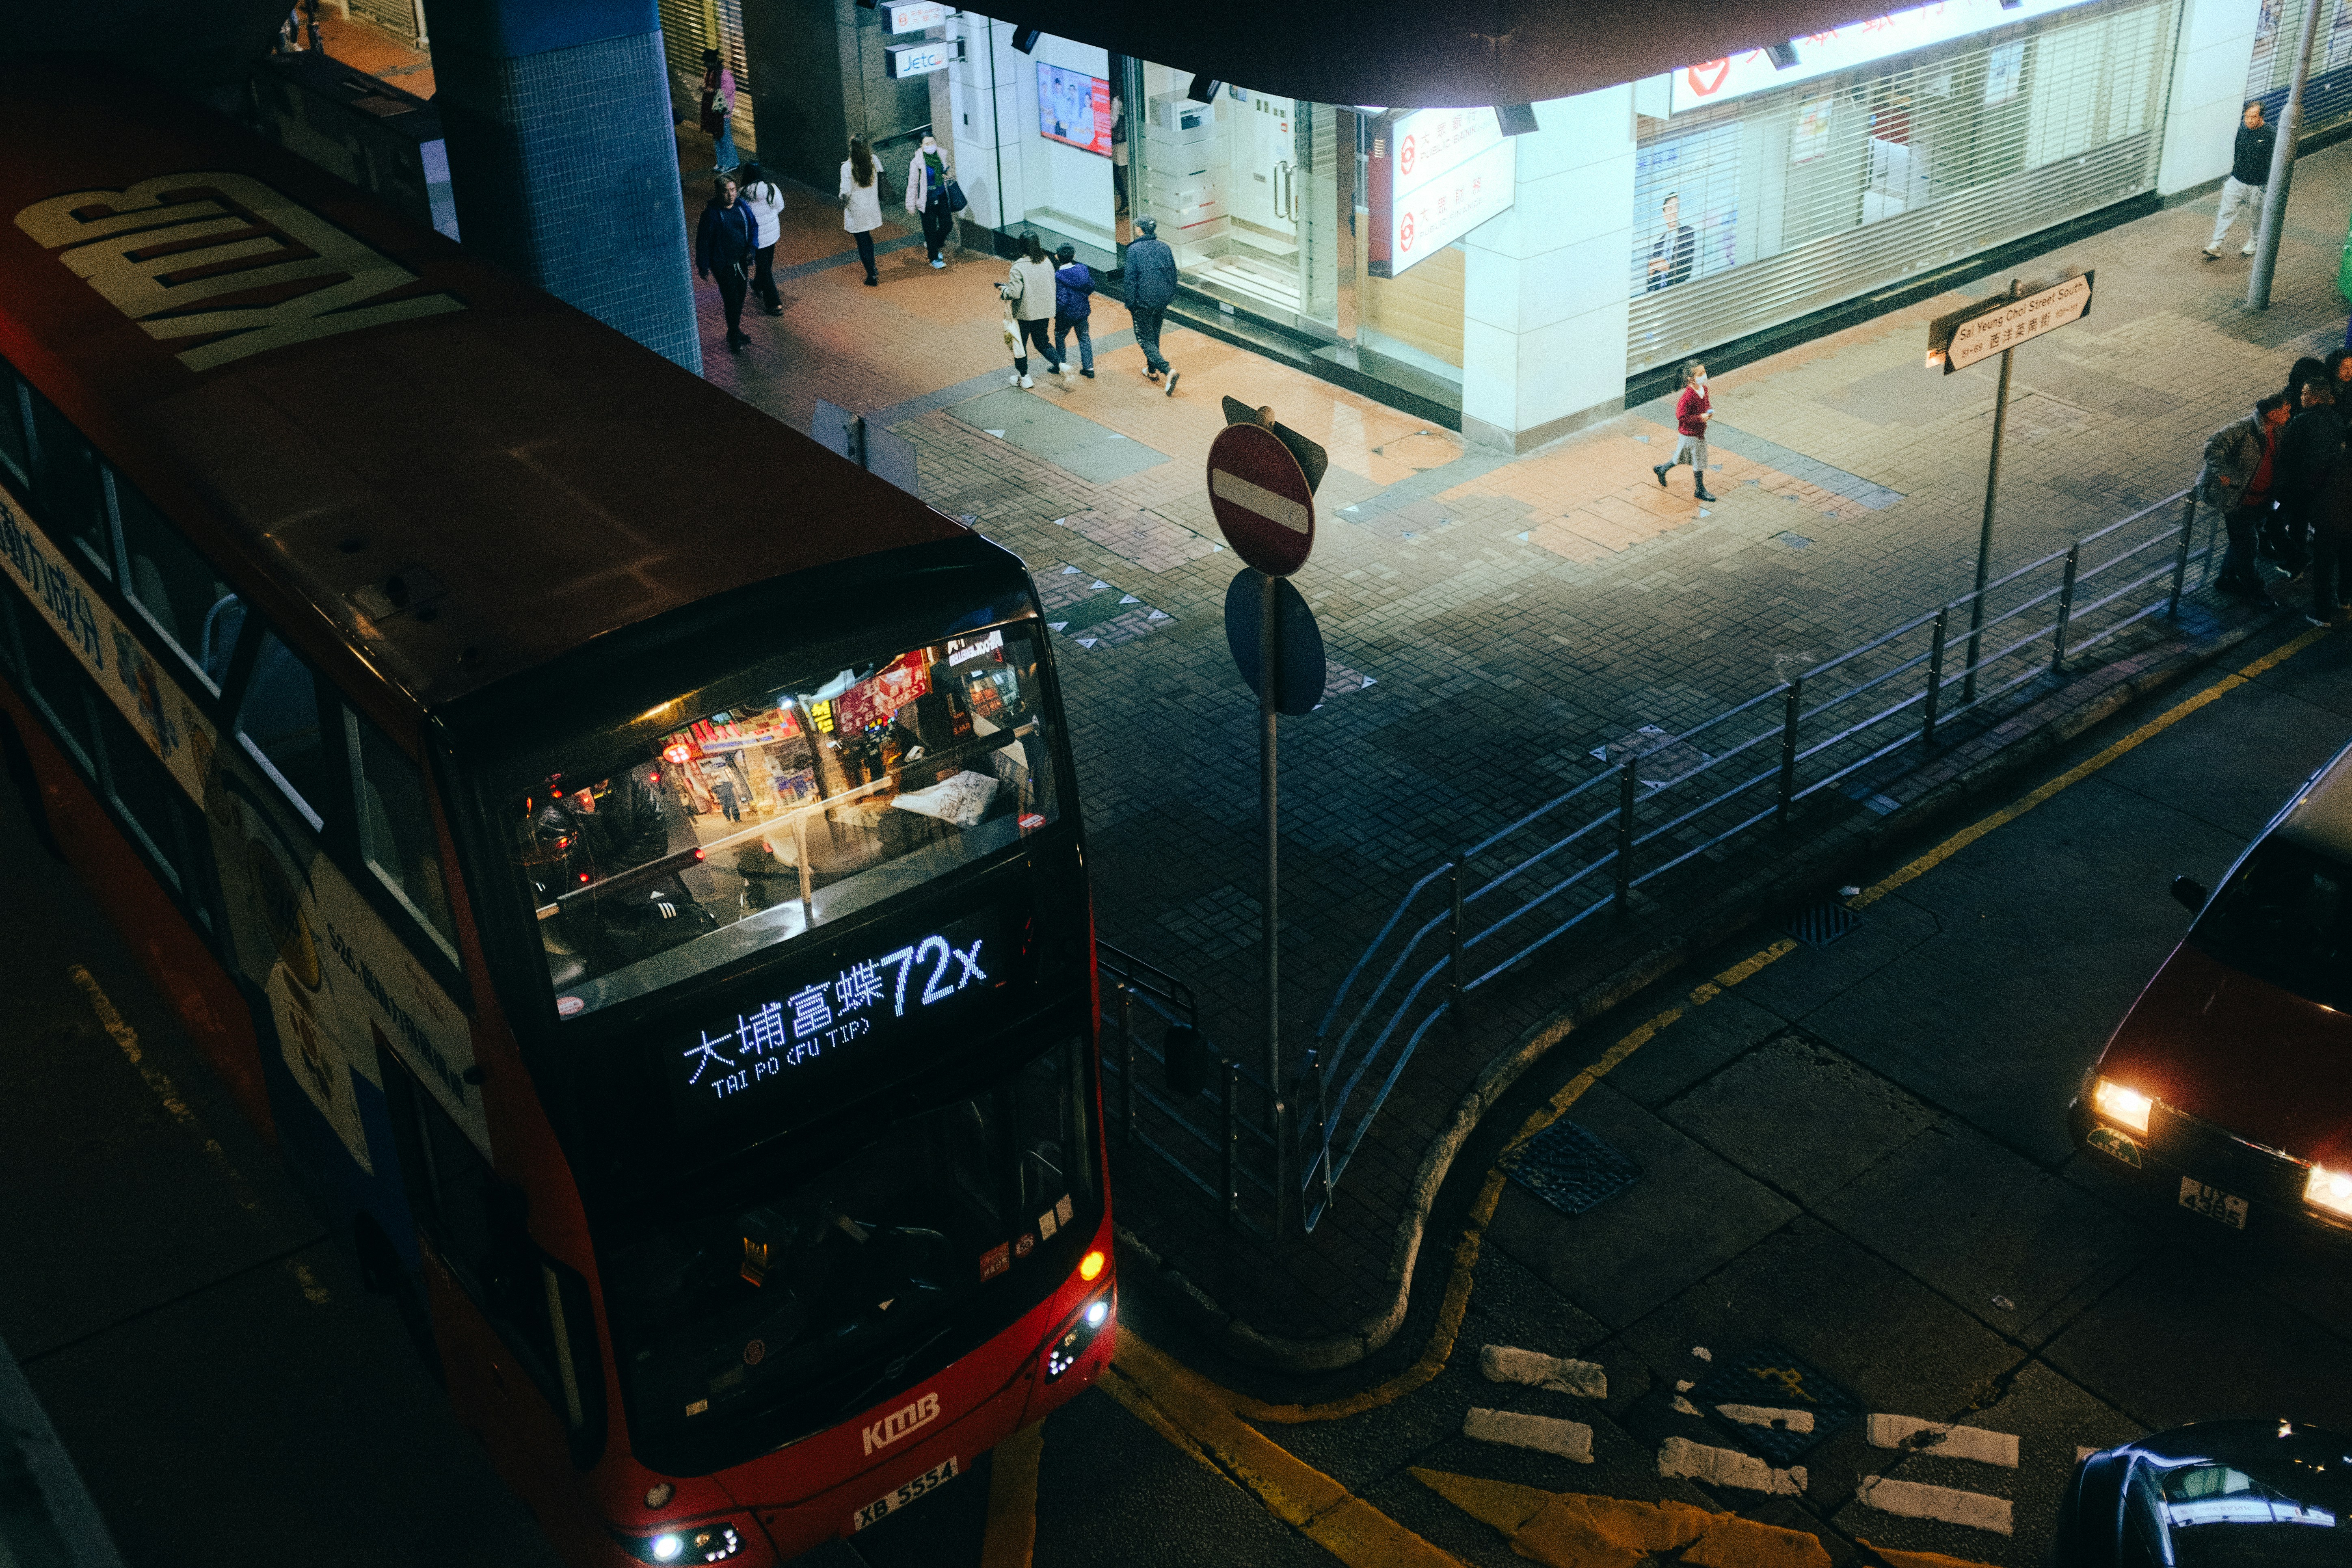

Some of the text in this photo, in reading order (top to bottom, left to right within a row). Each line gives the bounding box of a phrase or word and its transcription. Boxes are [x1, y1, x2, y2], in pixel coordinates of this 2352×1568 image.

[1420, 125, 1477, 161] PUBLIC BANK
[1960, 282, 2083, 341] Sai Yeung Choi Street South
[1989, 311, 2051, 350] 西洋菜南街
[683, 958, 885, 1085] 大埔富蝶
[711, 1016, 869, 1099] TAI PO (FU TIP)
[861, 1392, 940, 1456] KMB
[859, 1461, 953, 1527] XB 5554
